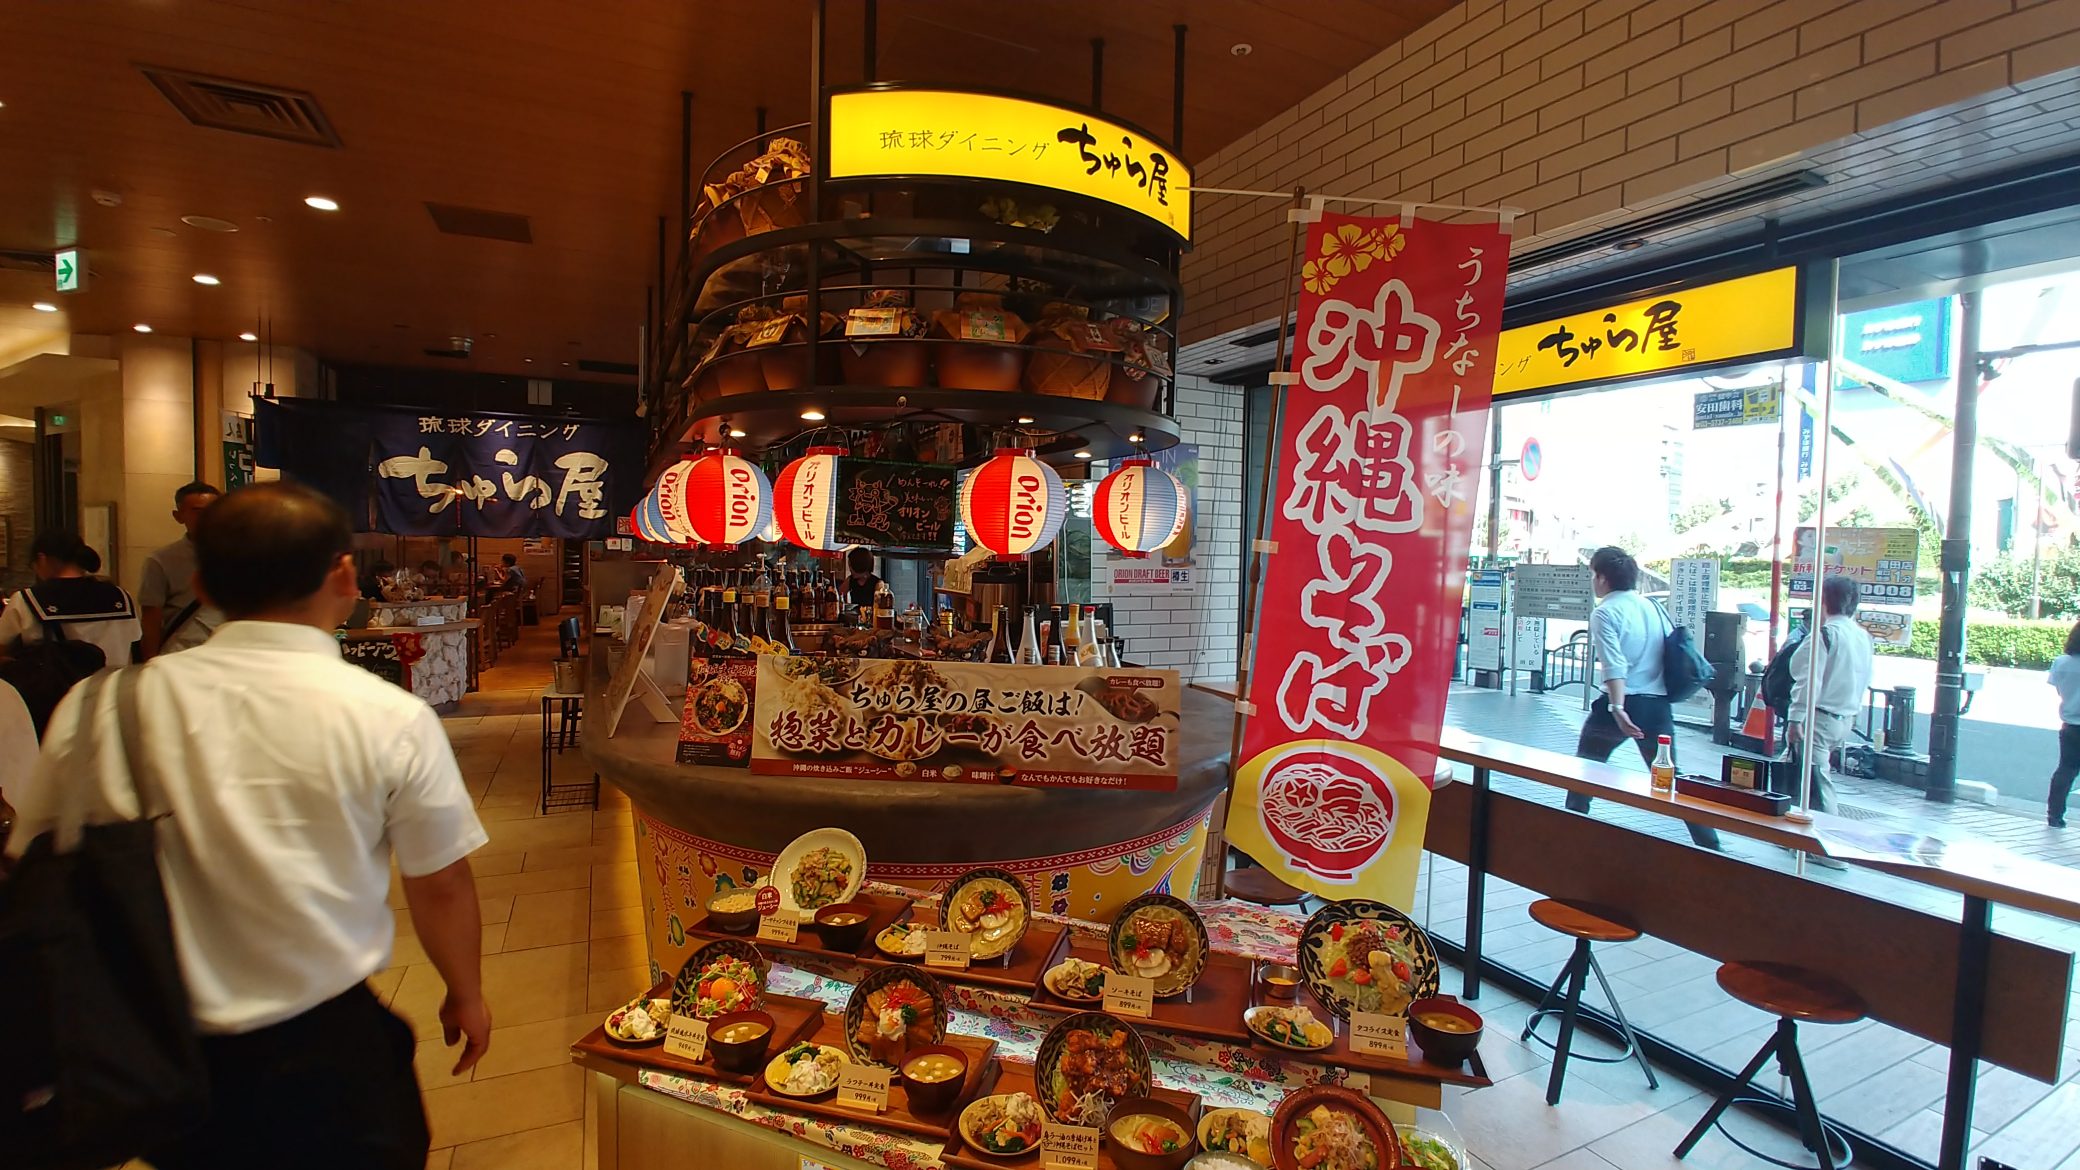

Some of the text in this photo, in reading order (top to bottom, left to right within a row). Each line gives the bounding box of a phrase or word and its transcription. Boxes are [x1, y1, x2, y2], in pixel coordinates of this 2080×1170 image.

[879, 122, 1169, 207] 琉球ダイニング ちゅら屋
[1537, 300, 1683, 368] ちゅら屋
[1424, 247, 1484, 509] うちなーの味
[418, 415, 581, 441] 琉球ダイニング
[1695, 399, 1743, 415] 安田歯科
[378, 445, 609, 520] ちゅら屋
[730, 468, 756, 527] Orion
[801, 461, 821, 541] オリオンビール
[915, 519, 942, 532] ビール
[1010, 475, 1043, 539] Orion
[1119, 473, 1135, 540] オリオンビール
[1276, 279, 1441, 740] 沖縄そば
[1114, 568, 1170, 579] ORION DRAFT BEER
[850, 682, 1084, 717] ちゅら屋の昼ご飯は!
[1110, 678, 1162, 687] カレーも食べ放題!
[769, 708, 1167, 768] 惣菜とカレーが食べ放題
[921, 769, 937, 778] 白米
[971, 771, 996, 780] 味噌汁
[1021, 773, 1128, 786] なんでもかんでもお好きなだけ!
[1357, 1024, 1400, 1037] タコライス定食
